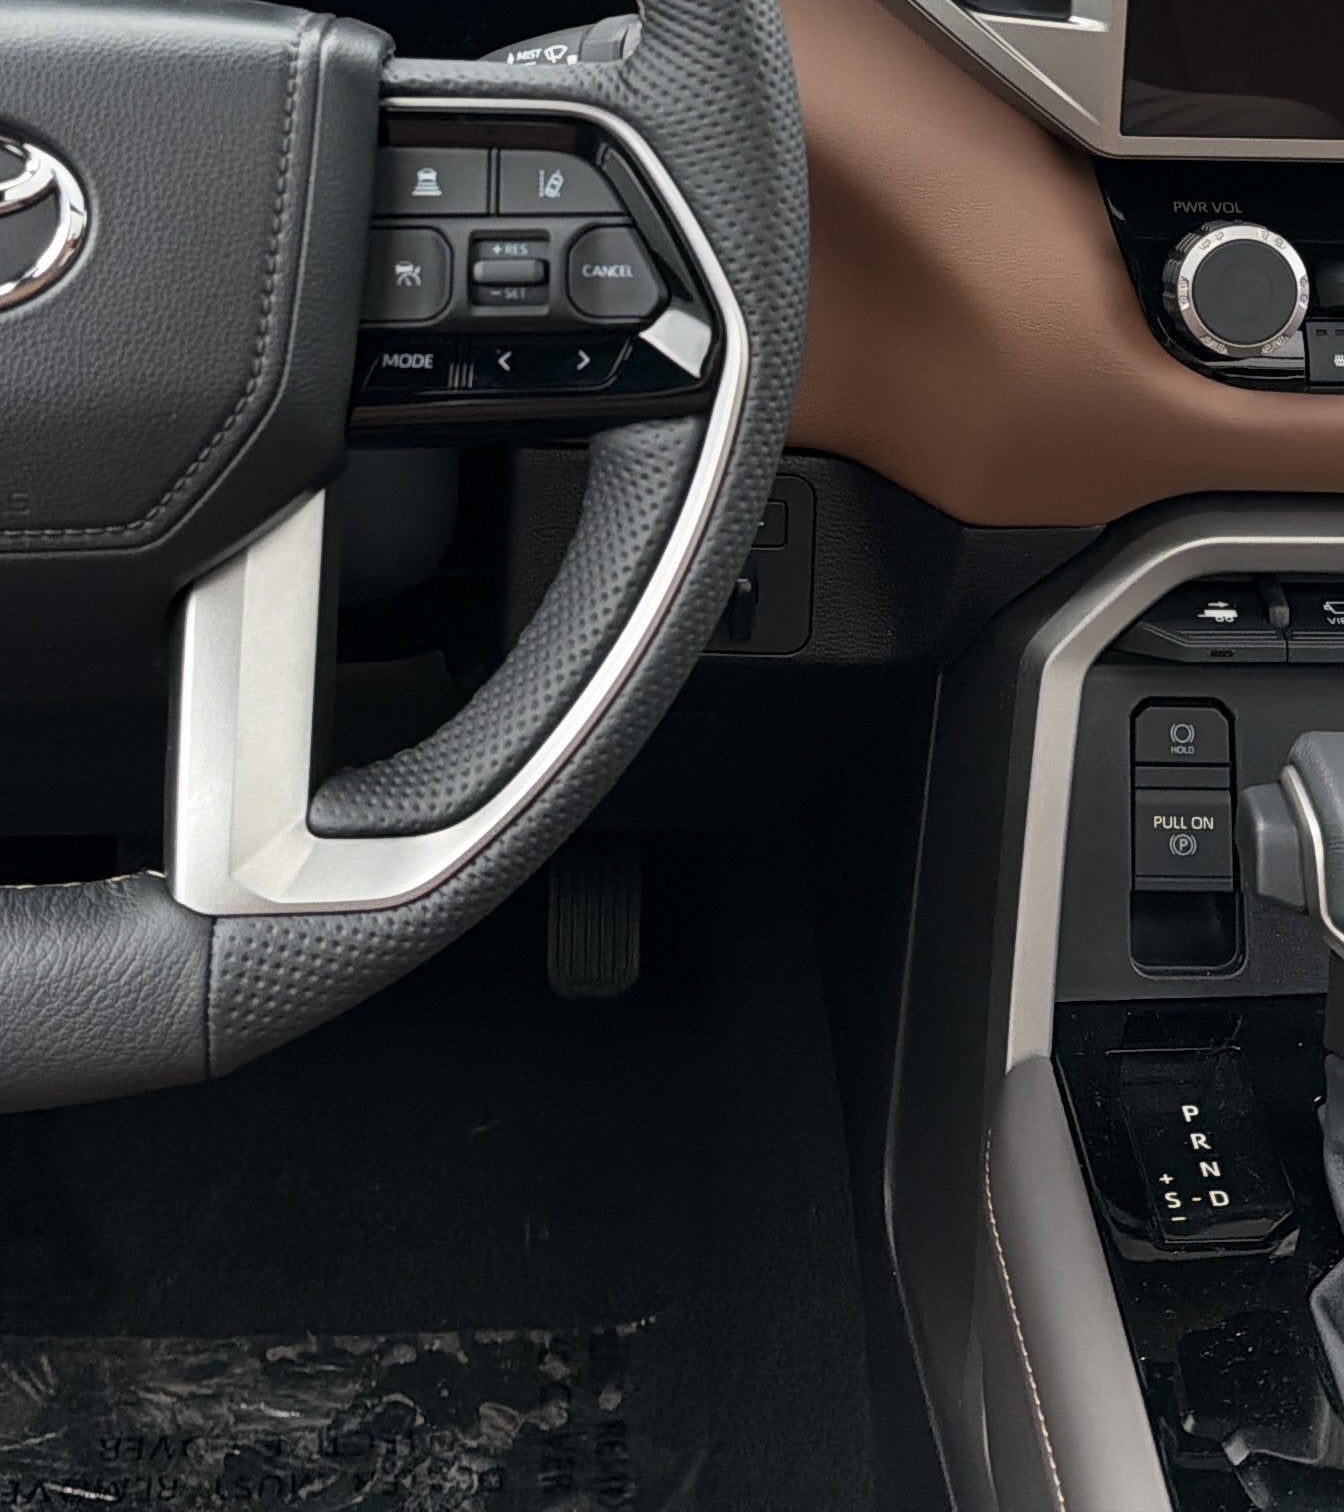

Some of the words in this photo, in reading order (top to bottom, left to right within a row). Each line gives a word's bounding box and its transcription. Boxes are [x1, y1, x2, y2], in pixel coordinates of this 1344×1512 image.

[517, 49, 543, 61] MIST
[1173, 201, 1208, 213] PWR
[1211, 202, 1243, 214] VOL
[581, 264, 633, 278] CANCEL
[382, 353, 434, 369] MODE
[1170, 745, 1195, 754] HOLD
[1153, 816, 1187, 829] PULL
[1191, 816, 1214, 829] ON
[1182, 1105, 1199, 1122] P
[1190, 1133, 1211, 1150] R
[1200, 1161, 1221, 1178] N
[1164, 1192, 1181, 1209] S
[1209, 1190, 1230, 1207] D
